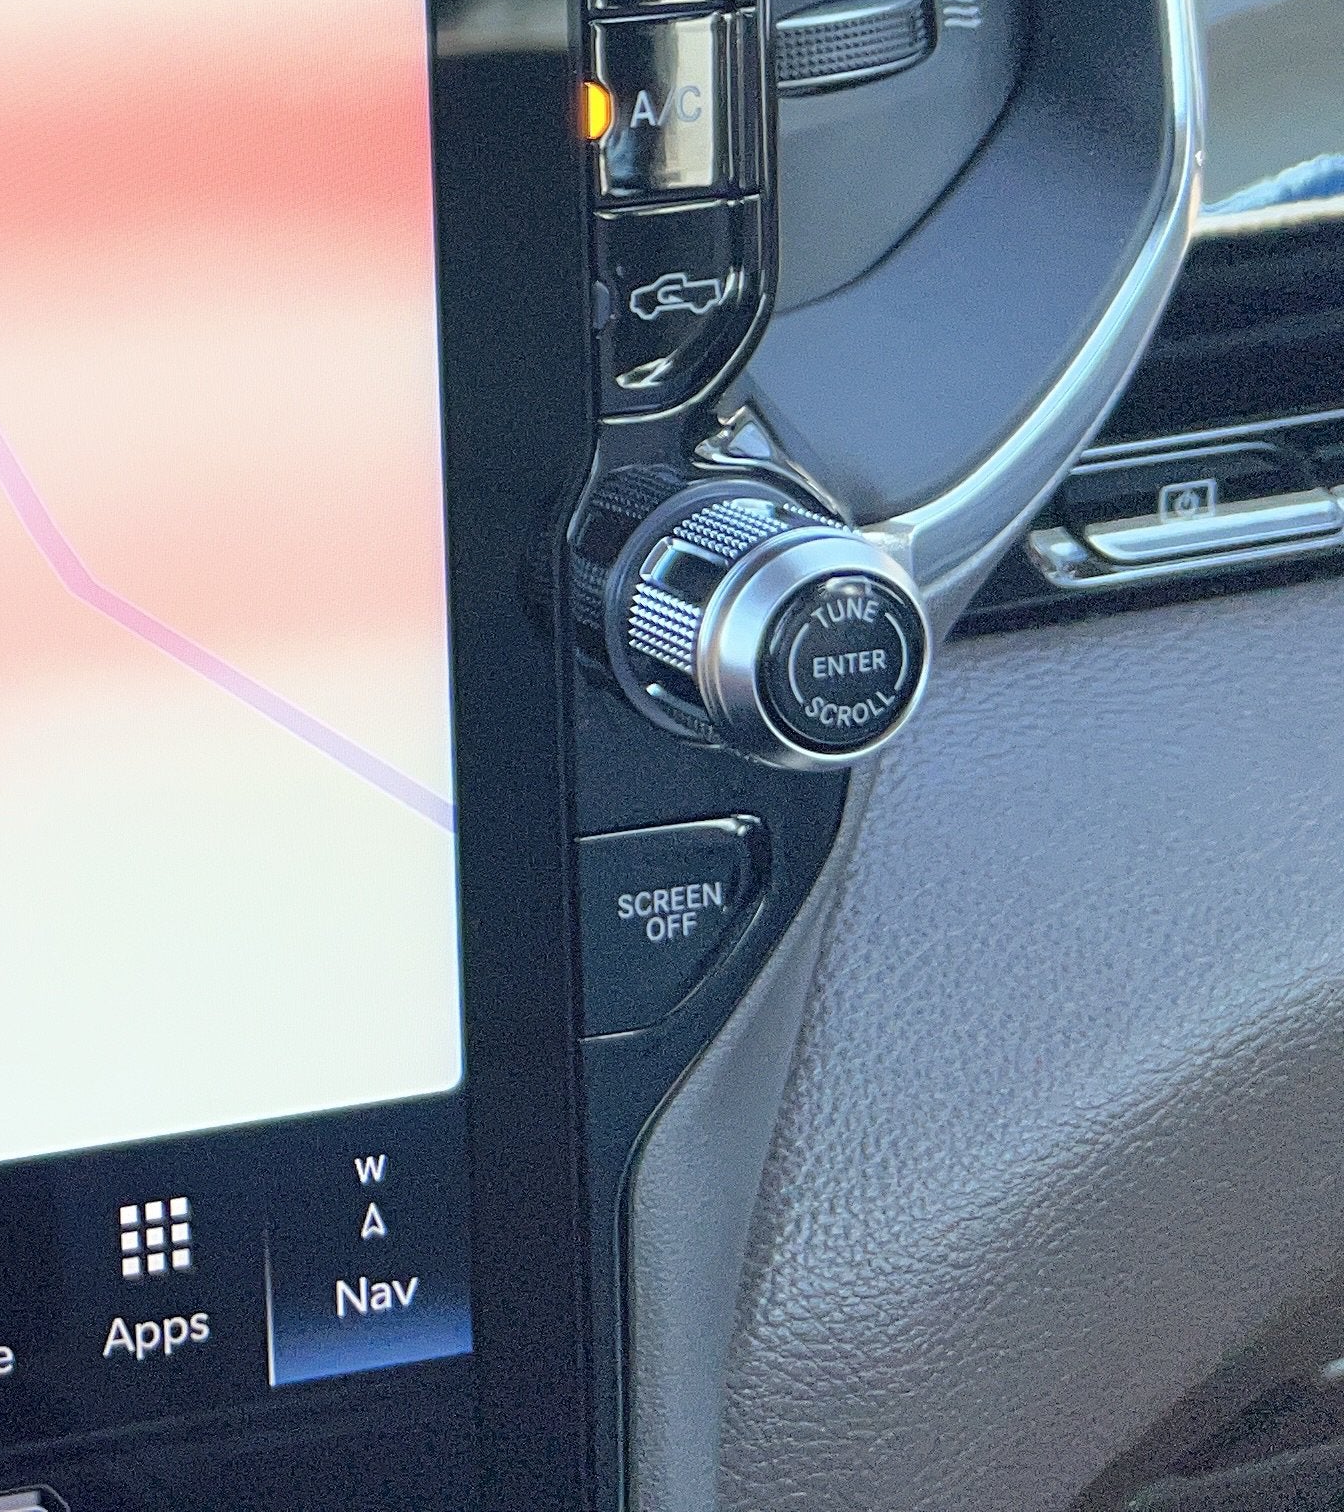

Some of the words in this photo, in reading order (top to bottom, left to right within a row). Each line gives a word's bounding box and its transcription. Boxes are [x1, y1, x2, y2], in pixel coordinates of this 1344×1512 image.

[629, 85, 704, 129] A/C
[811, 596, 881, 628] TUNE
[812, 648, 886, 680] ENTER
[804, 688, 897, 728] SCROLL
[617, 882, 723, 921] SCREEN
[645, 913, 698, 942] OFF
[355, 1154, 388, 1184] W
[334, 1275, 419, 1318] Nav
[102, 1309, 212, 1362] Apps
